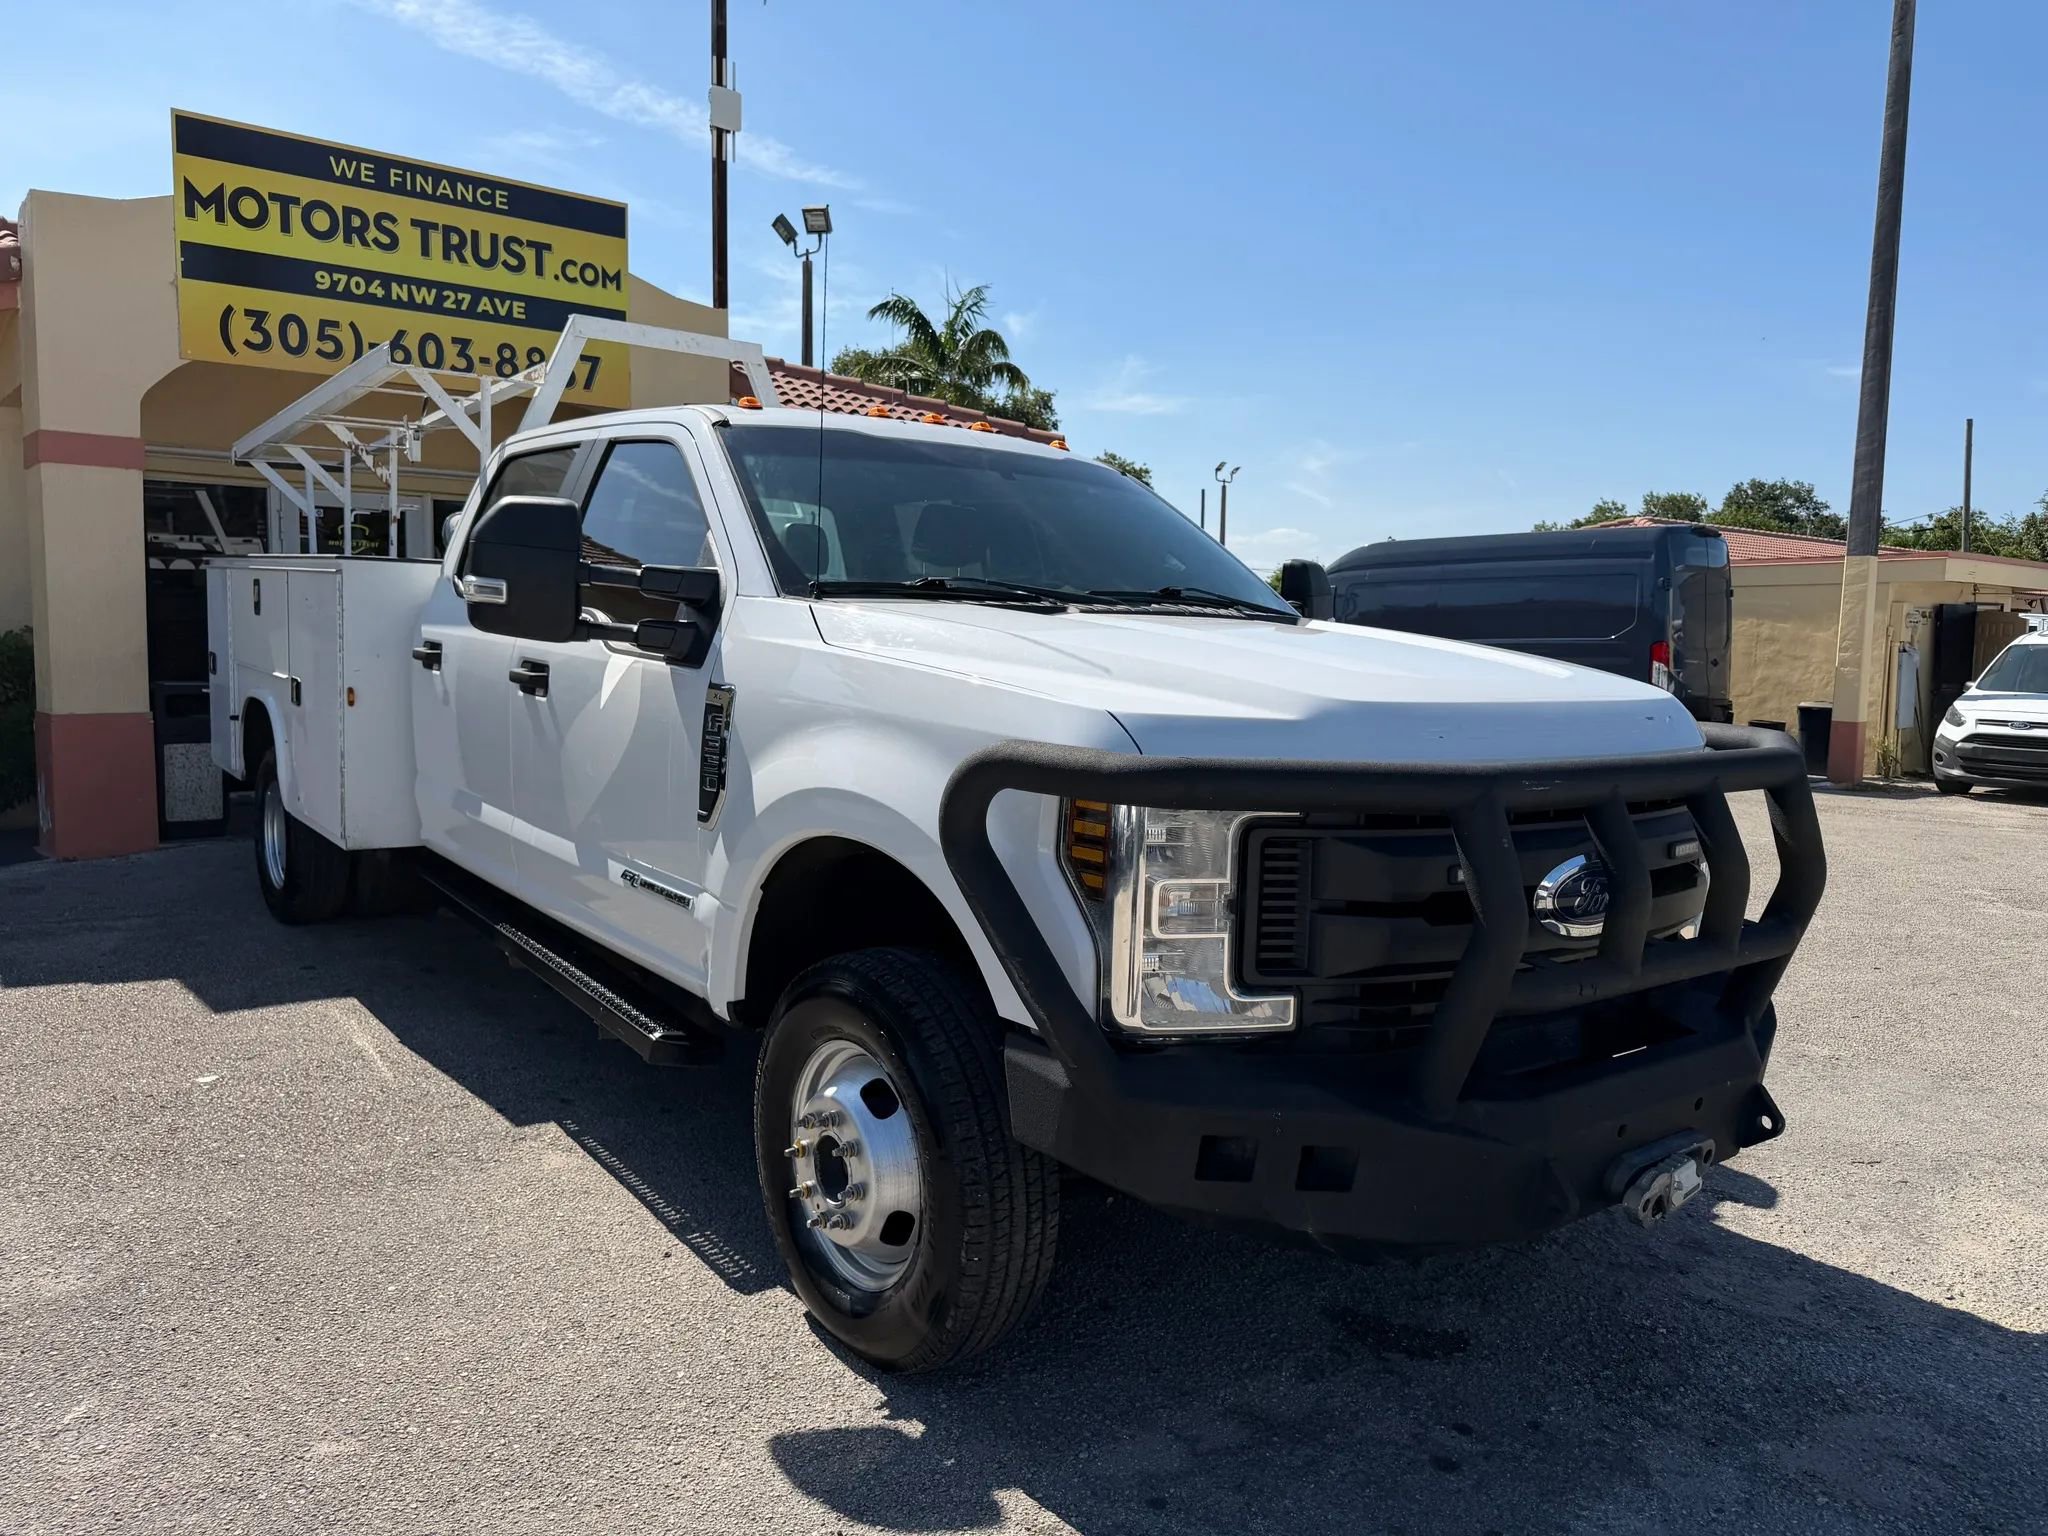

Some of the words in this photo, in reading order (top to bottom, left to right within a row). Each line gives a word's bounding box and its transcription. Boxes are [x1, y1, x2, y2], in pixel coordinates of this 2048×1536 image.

[183, 175, 400, 253] MOTORS
[329, 155, 375, 183] WE
[389, 168, 509, 210] FINANCE
[315, 270, 385, 299] 9704
[391, 282, 437, 306] NW
[442, 289, 472, 311] 27
[476, 297, 526, 320] AVE
[219, 304, 602, 392] (305)-603-887
